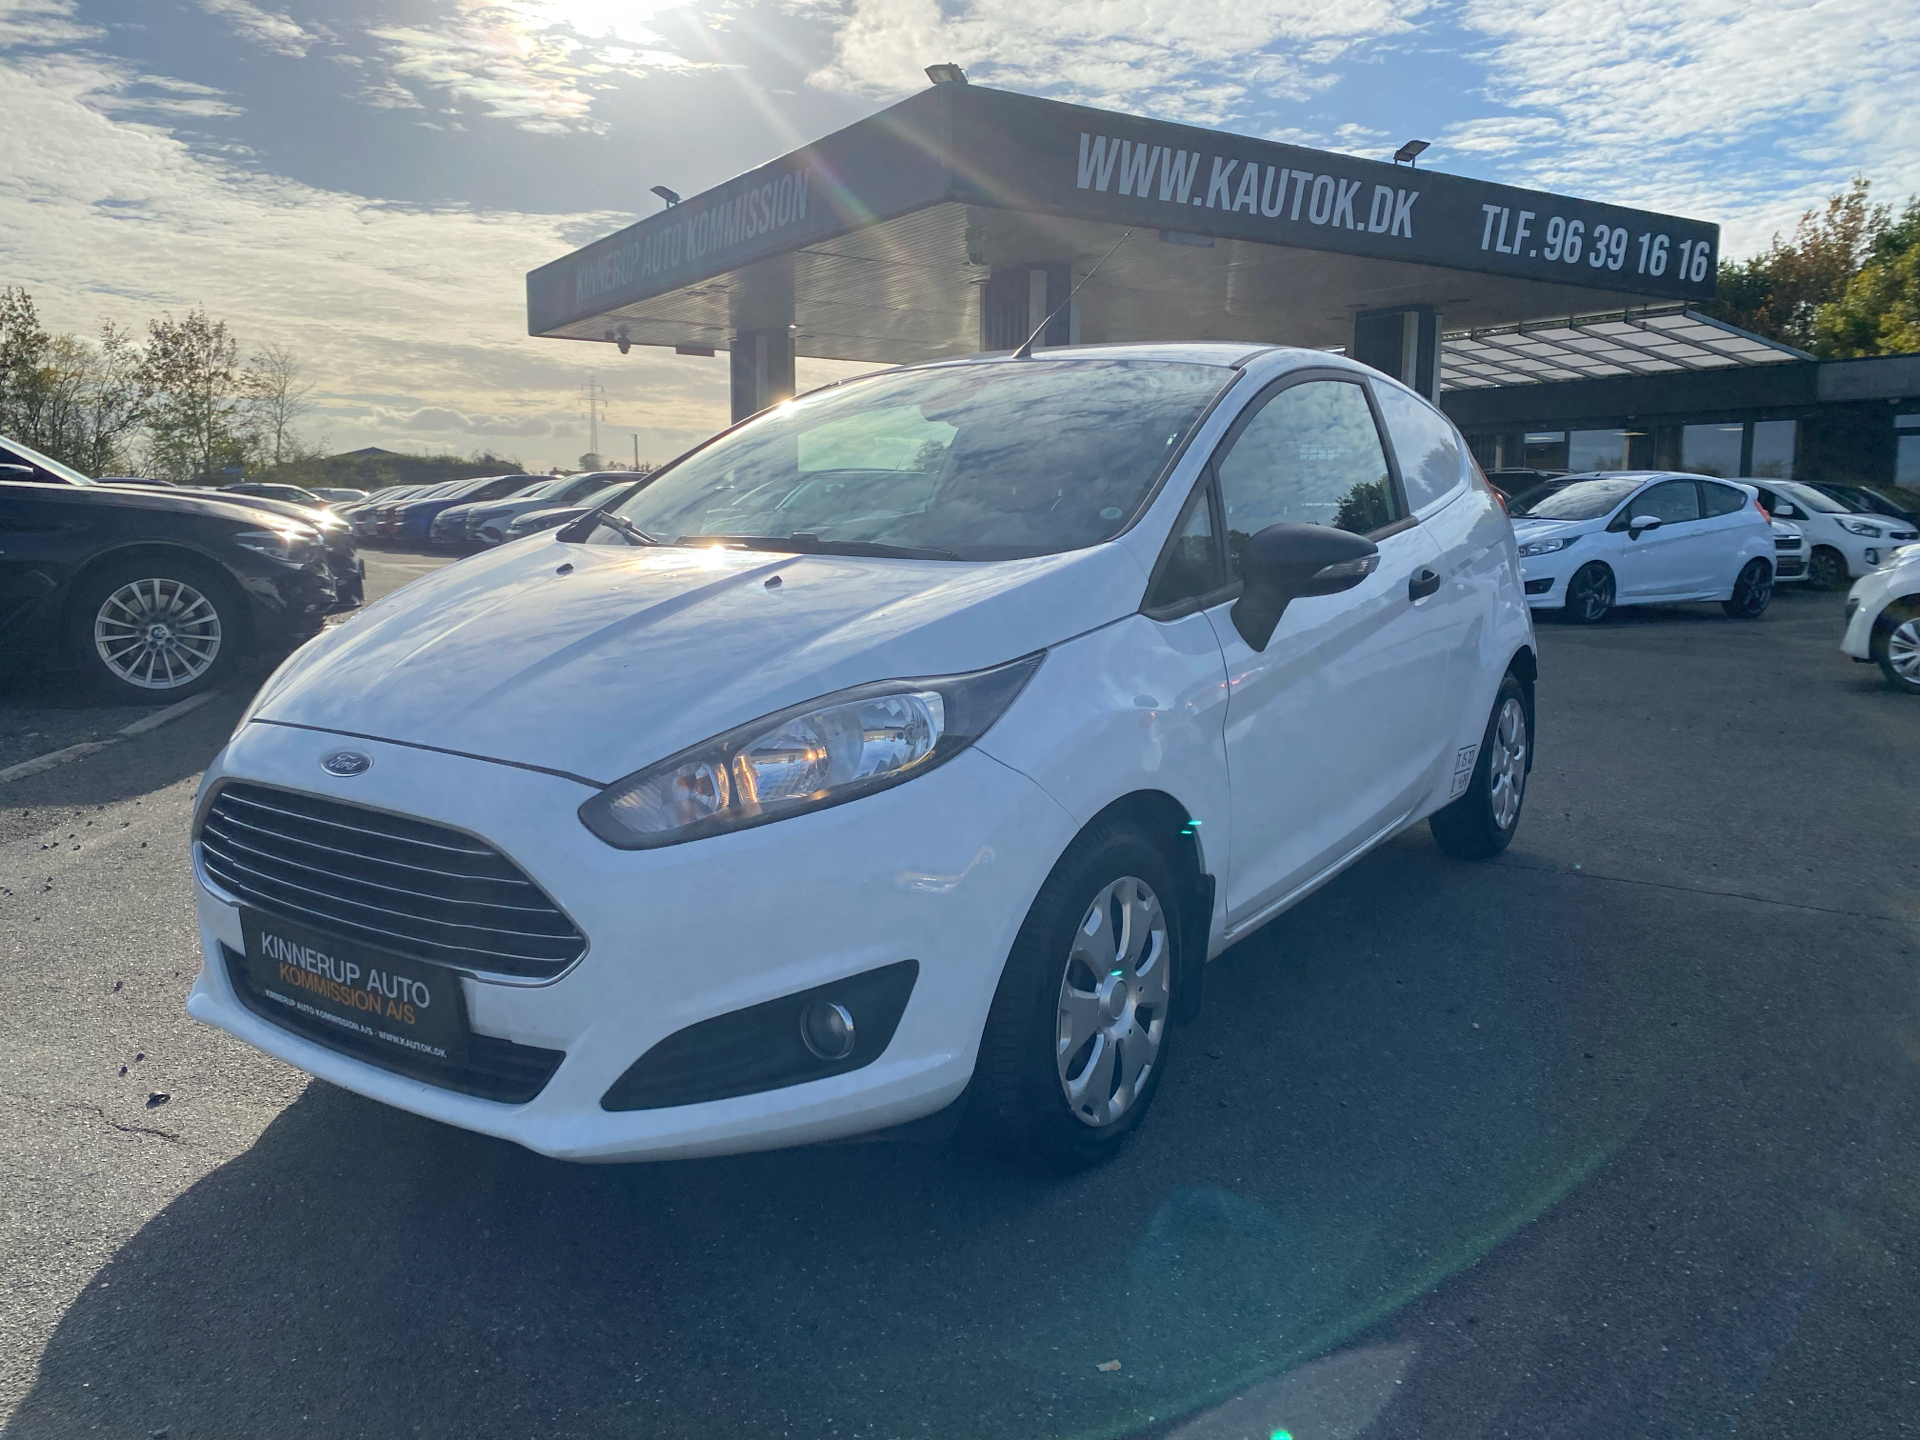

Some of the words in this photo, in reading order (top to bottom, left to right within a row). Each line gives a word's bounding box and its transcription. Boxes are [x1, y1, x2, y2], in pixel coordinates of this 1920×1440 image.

[576, 241, 639, 303] KINNERUP
[641, 223, 682, 278] AUTO
[686, 166, 810, 262] KOMMISSION
[1076, 131, 1420, 239] WWW.KAUTOK.DK
[1481, 203, 1537, 259] TLF.
[1543, 216, 1583, 265] 96
[1589, 223, 1628, 271] 39
[1637, 232, 1667, 277] 16
[1678, 238, 1711, 283] 16
[329, 753, 362, 770] Ford
[261, 931, 360, 986] KINNERUP
[367, 969, 431, 1009] AUTO
[279, 963, 382, 1015] KOMMISSION
[385, 1000, 416, 1025] A/S
[265, 989, 295, 1007] KINNERUP
[297, 1001, 315, 1015] AUTO
[315, 1008, 359, 1031] KOMMISSION
[360, 1025, 373, 1036] A/S
[378, 1030, 447, 1058] WWW.KAUTOK.DK
